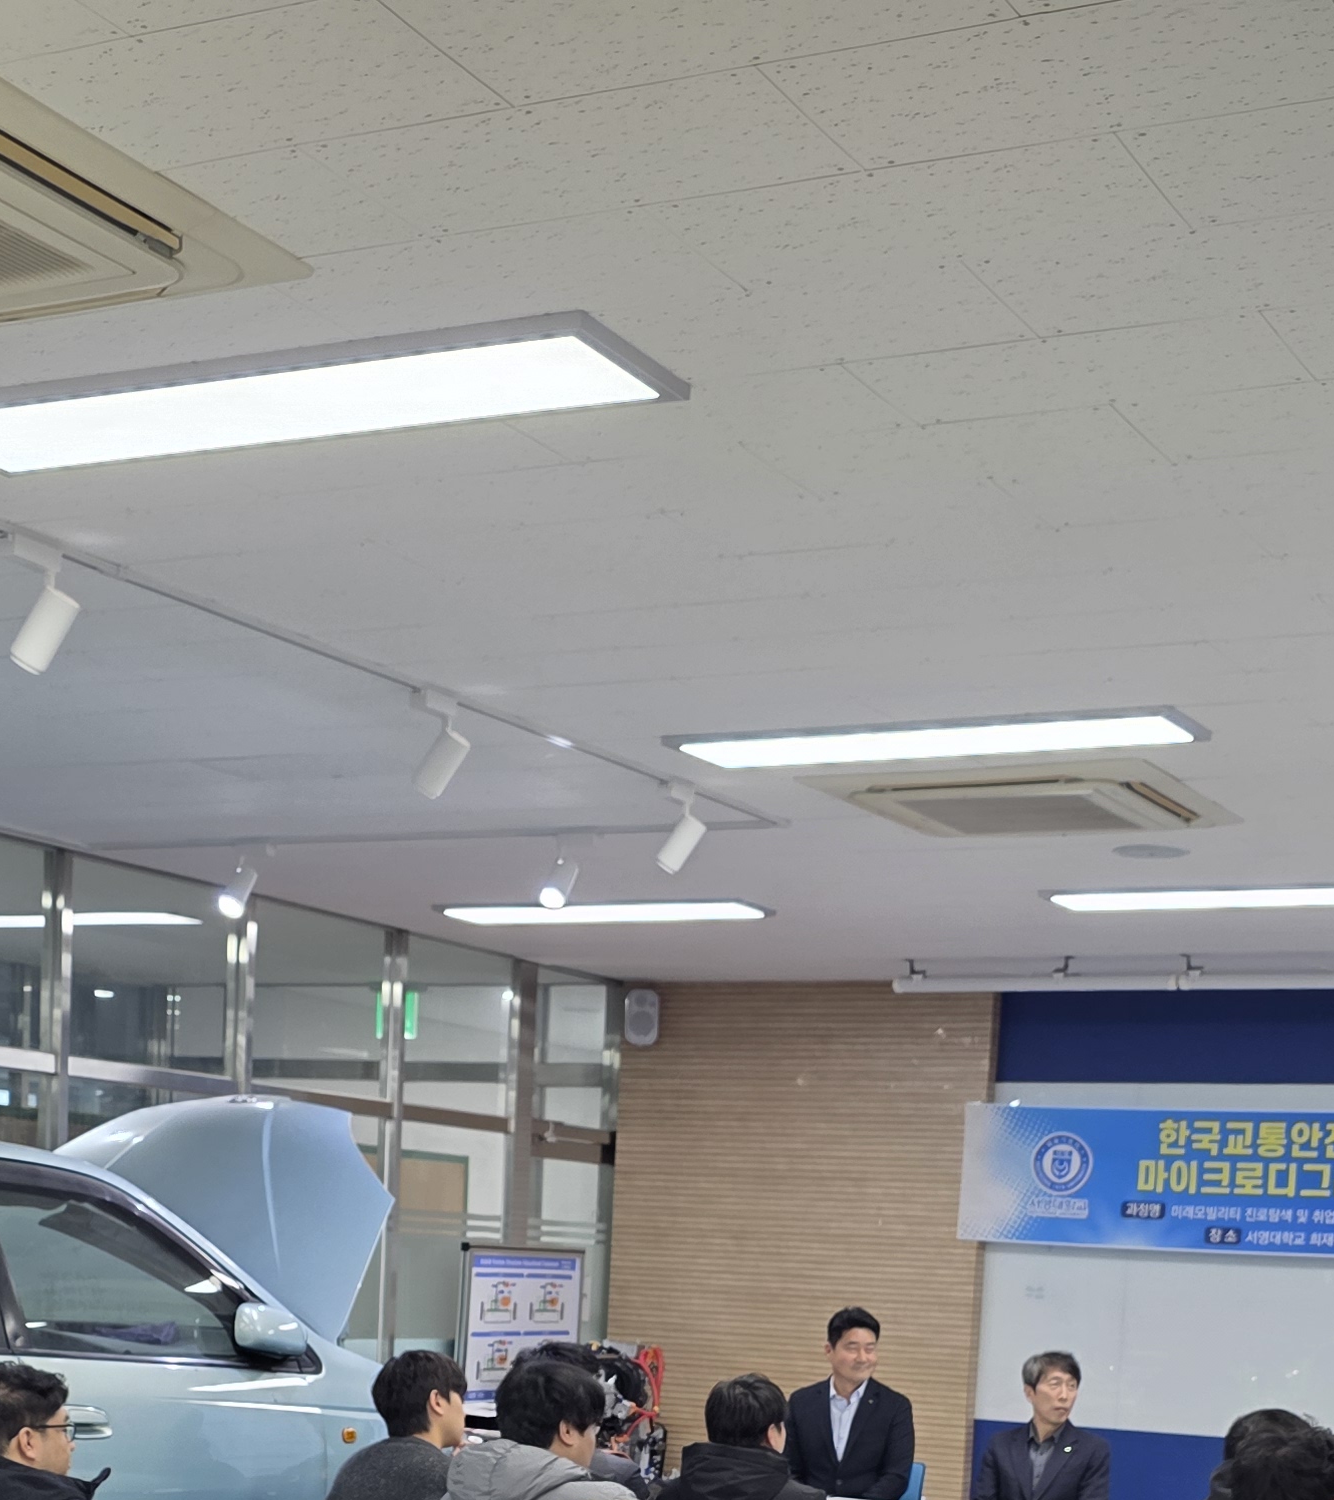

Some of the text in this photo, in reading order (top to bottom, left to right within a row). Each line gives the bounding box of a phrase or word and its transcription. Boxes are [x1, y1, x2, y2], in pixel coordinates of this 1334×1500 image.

[1171, 1204, 1241, 1222] 미래모빌리티
[1244, 1206, 1292, 1224] 진로탐색
[1296, 1208, 1308, 1225] 및
[1244, 1229, 1306, 1246] 서영대학교
